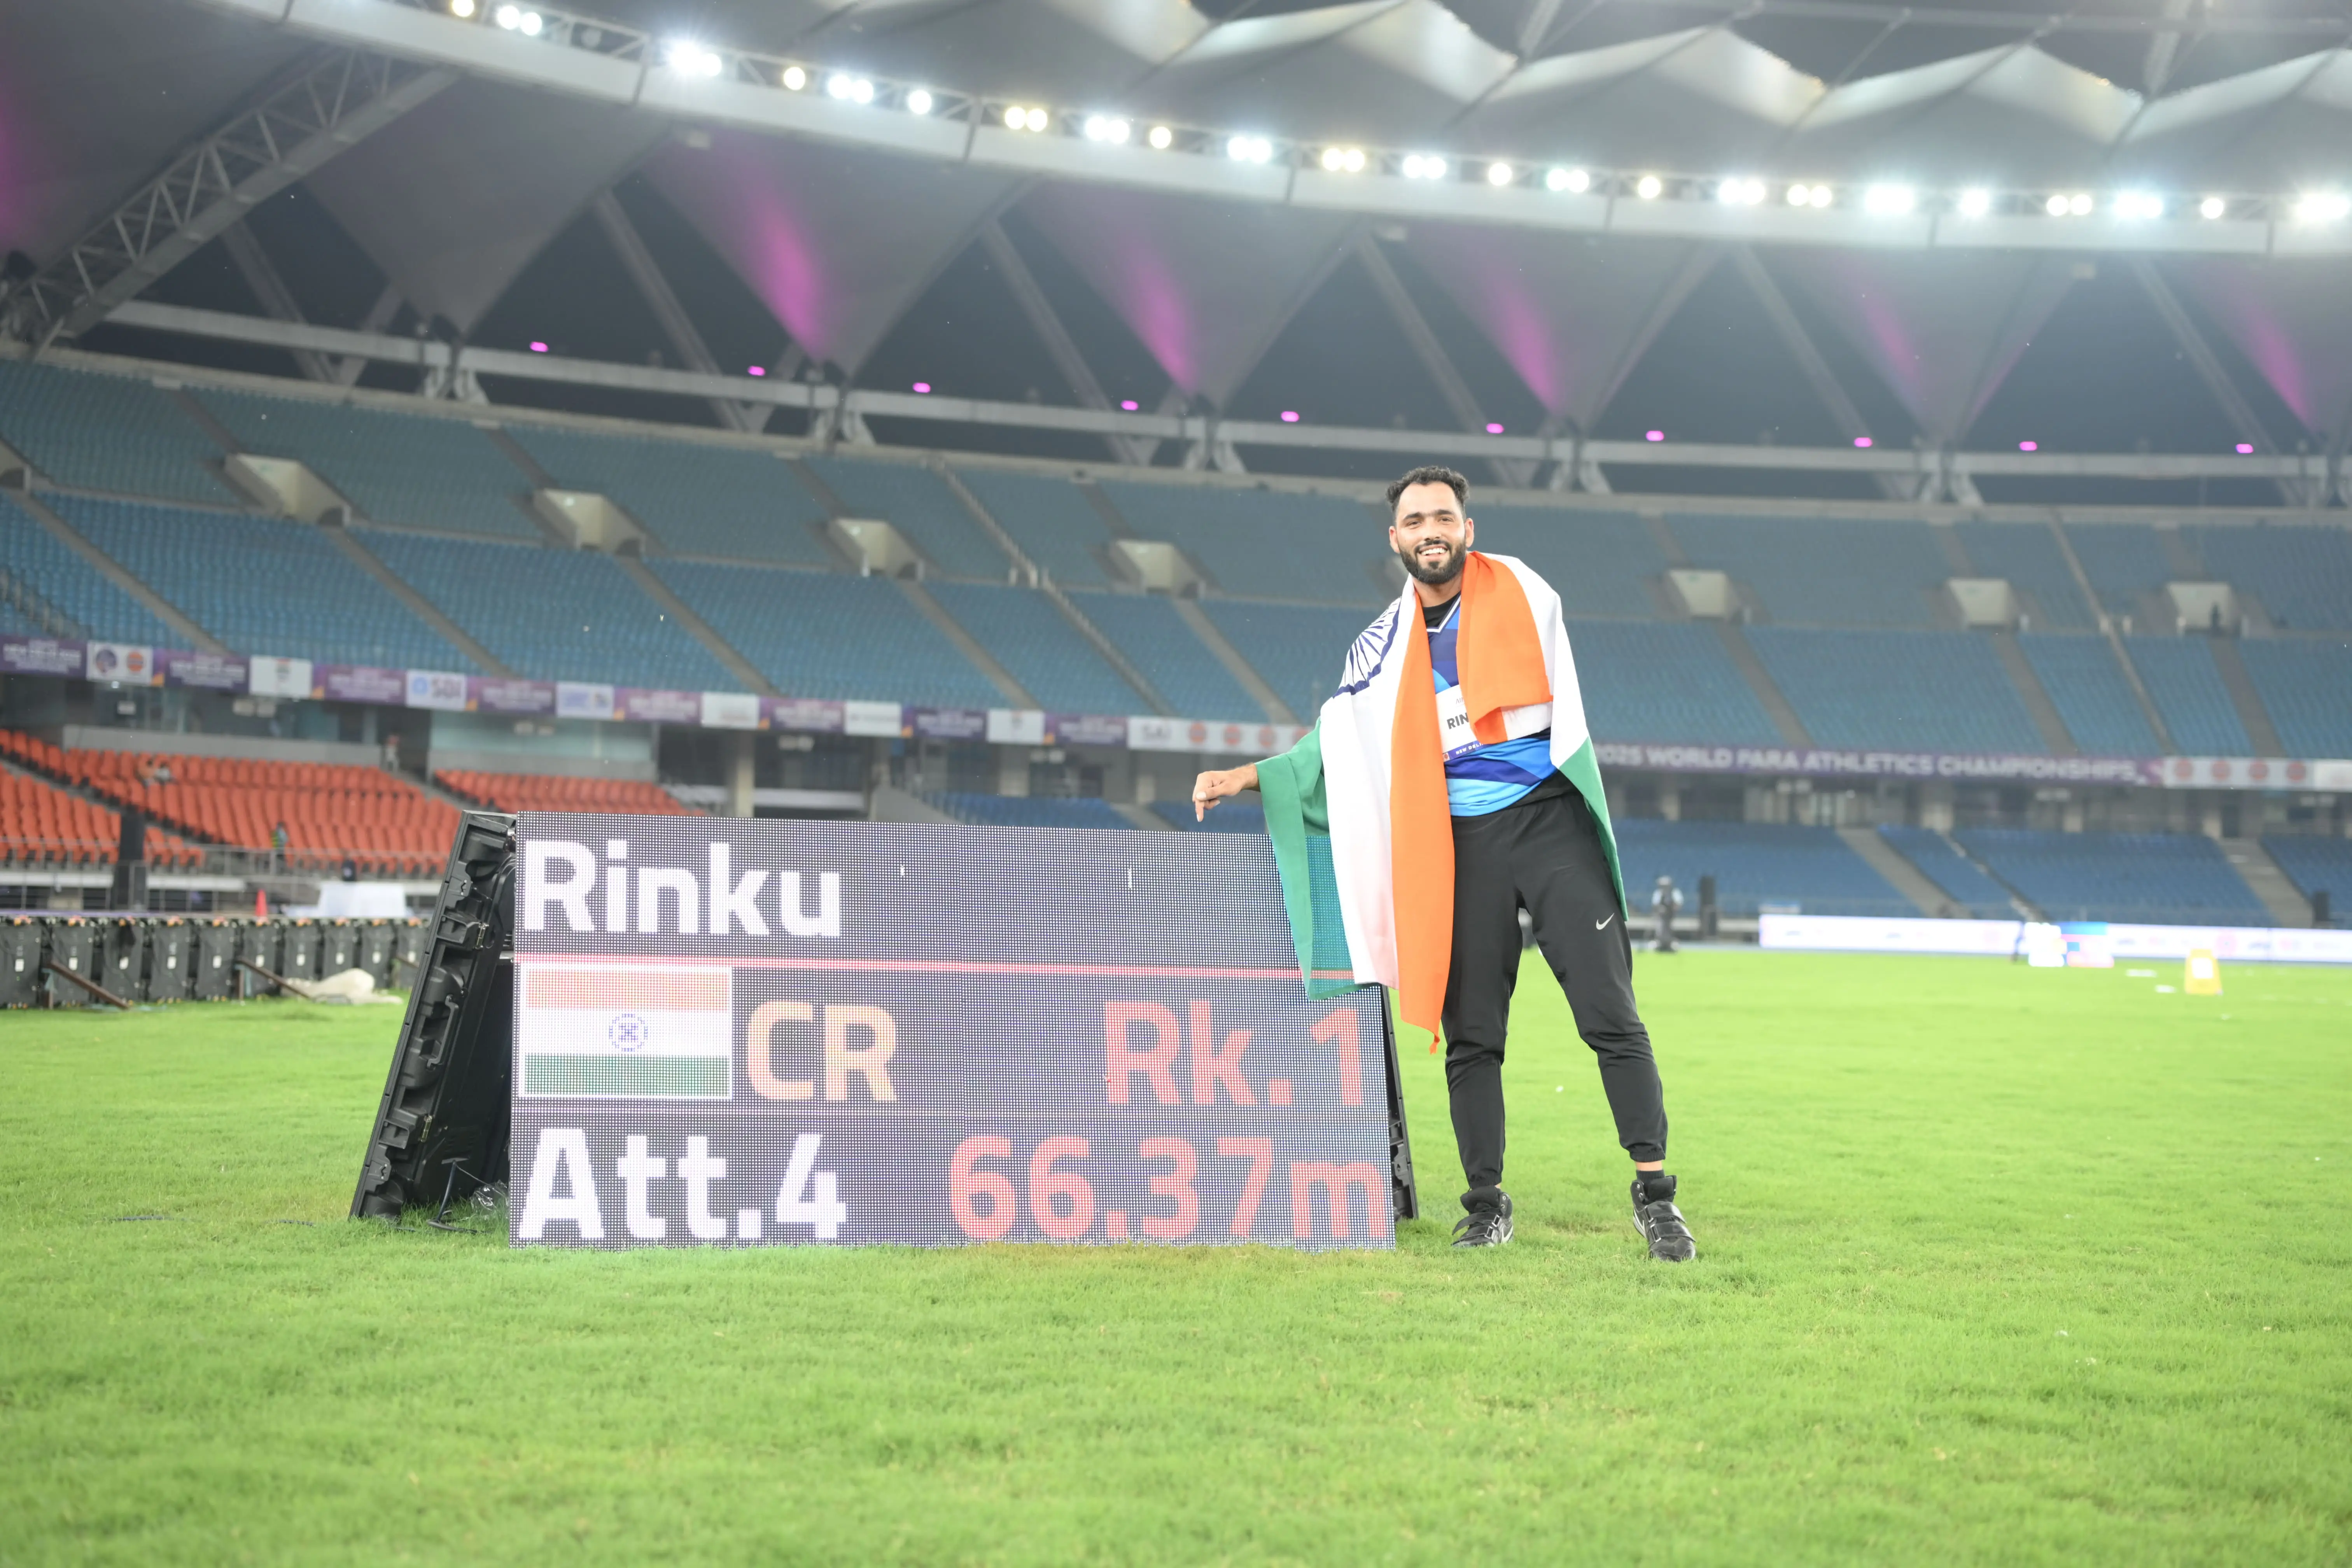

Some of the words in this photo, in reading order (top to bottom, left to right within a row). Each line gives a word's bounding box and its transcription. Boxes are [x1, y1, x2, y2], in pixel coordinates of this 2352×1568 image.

[1647, 746, 1732, 768] WORLD
[1737, 749, 1797, 769] PARA
[1803, 750, 1934, 775] ATHLETICS
[1938, 754, 2134, 779] CHAMPIONSHIPS
[522, 839, 842, 938] Rinku
[746, 999, 899, 1103] CR
[519, 1129, 847, 1241] Att.4
[949, 1134, 1387, 1241] 66.37m
